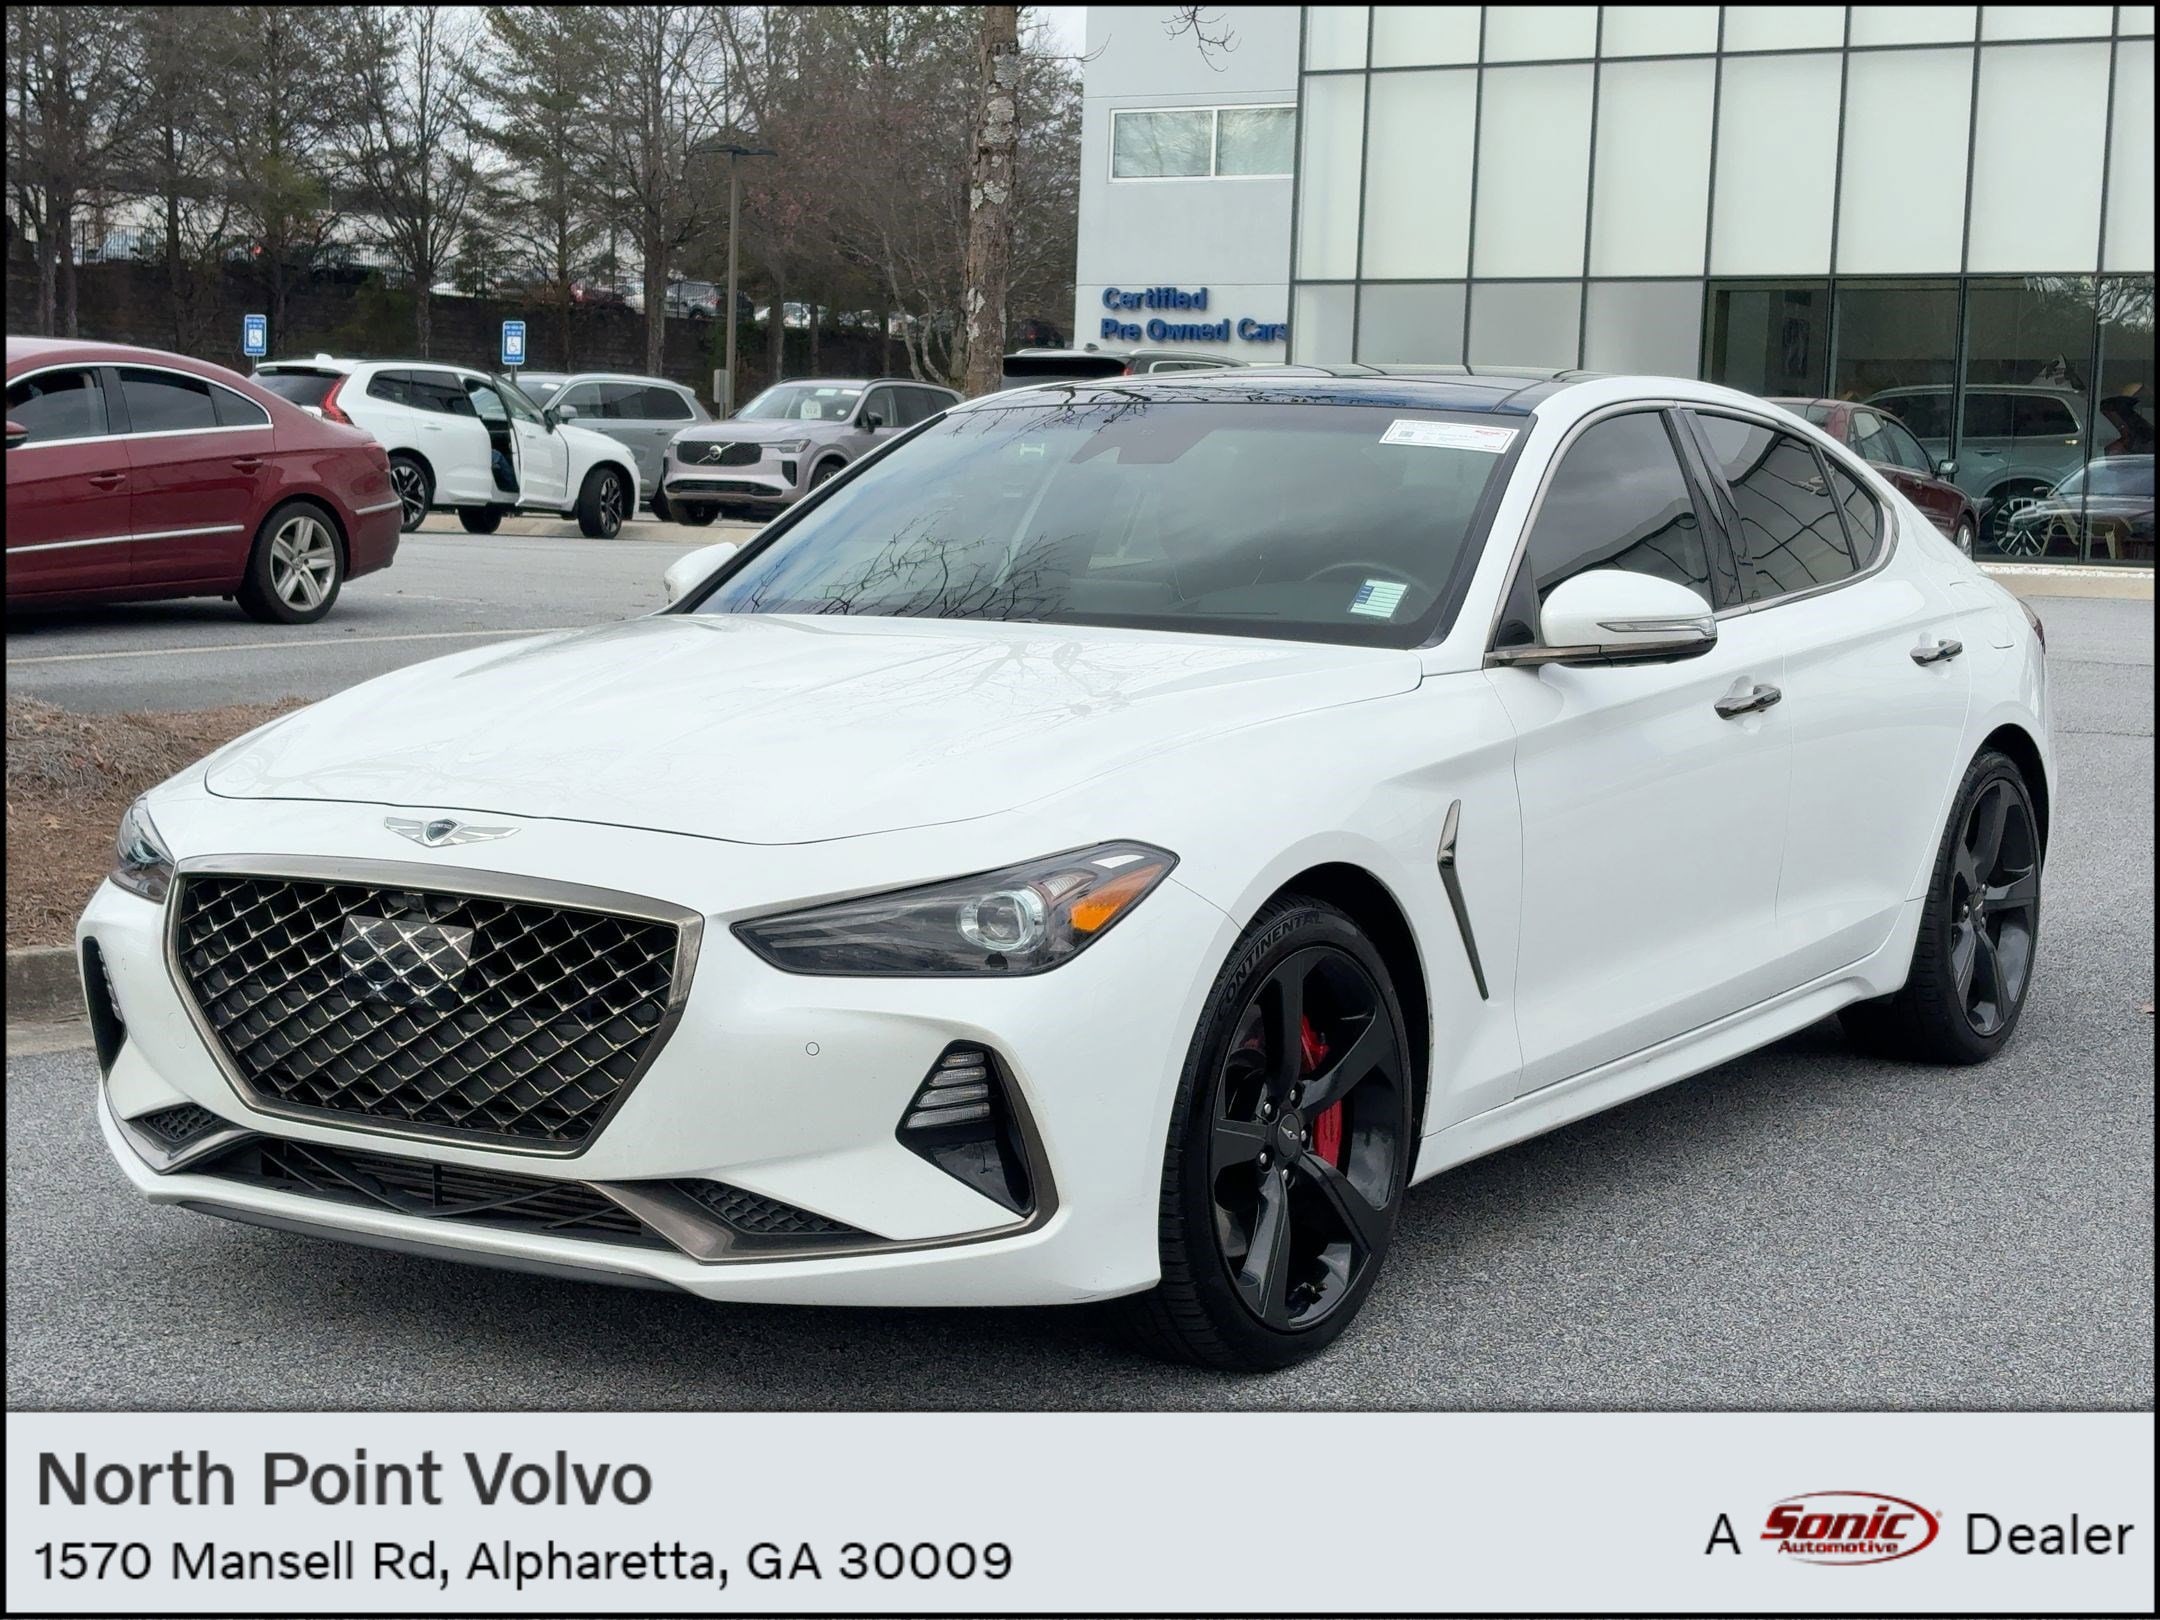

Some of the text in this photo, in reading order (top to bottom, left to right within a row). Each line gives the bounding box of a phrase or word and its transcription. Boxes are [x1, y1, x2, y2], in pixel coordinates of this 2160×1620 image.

[1102, 287, 1208, 310] Certified
[1101, 318, 1288, 341] Pre Owned Cars
